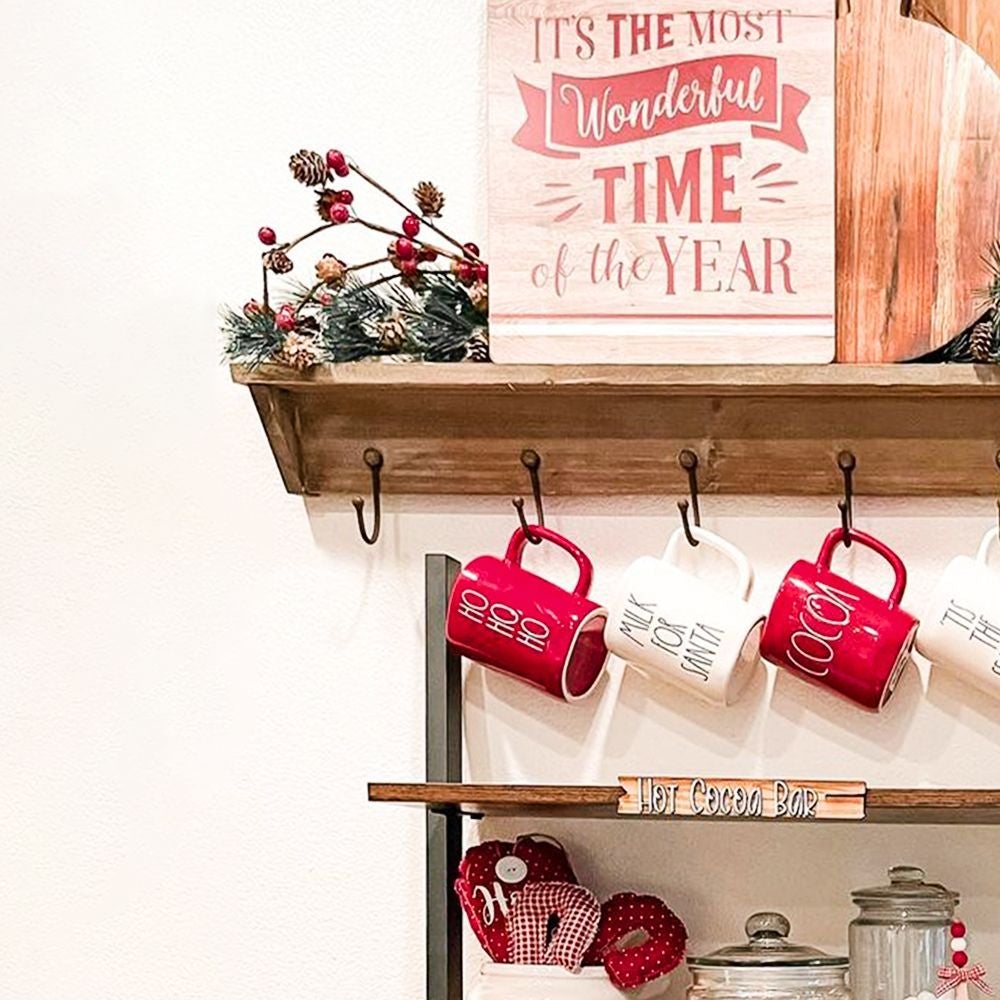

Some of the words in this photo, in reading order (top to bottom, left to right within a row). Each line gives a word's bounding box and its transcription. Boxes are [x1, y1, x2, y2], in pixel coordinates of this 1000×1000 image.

[532, 14, 597, 63] IT'S
[607, 12, 675, 60] THE
[687, 8, 792, 47] MOST
[560, 64, 766, 142] Wonderful
[593, 142, 744, 225] TIME
[531, 241, 577, 298] of
[589, 237, 655, 288] the
[655, 235, 798, 296] YEAR
[457, 589, 489, 624] HO
[515, 617, 550, 652] HO
[619, 593, 657, 647] MILK
[786, 580, 861, 677] COCOA
[650, 617, 688, 656] FOR
[680, 622, 725, 682] SANTA
